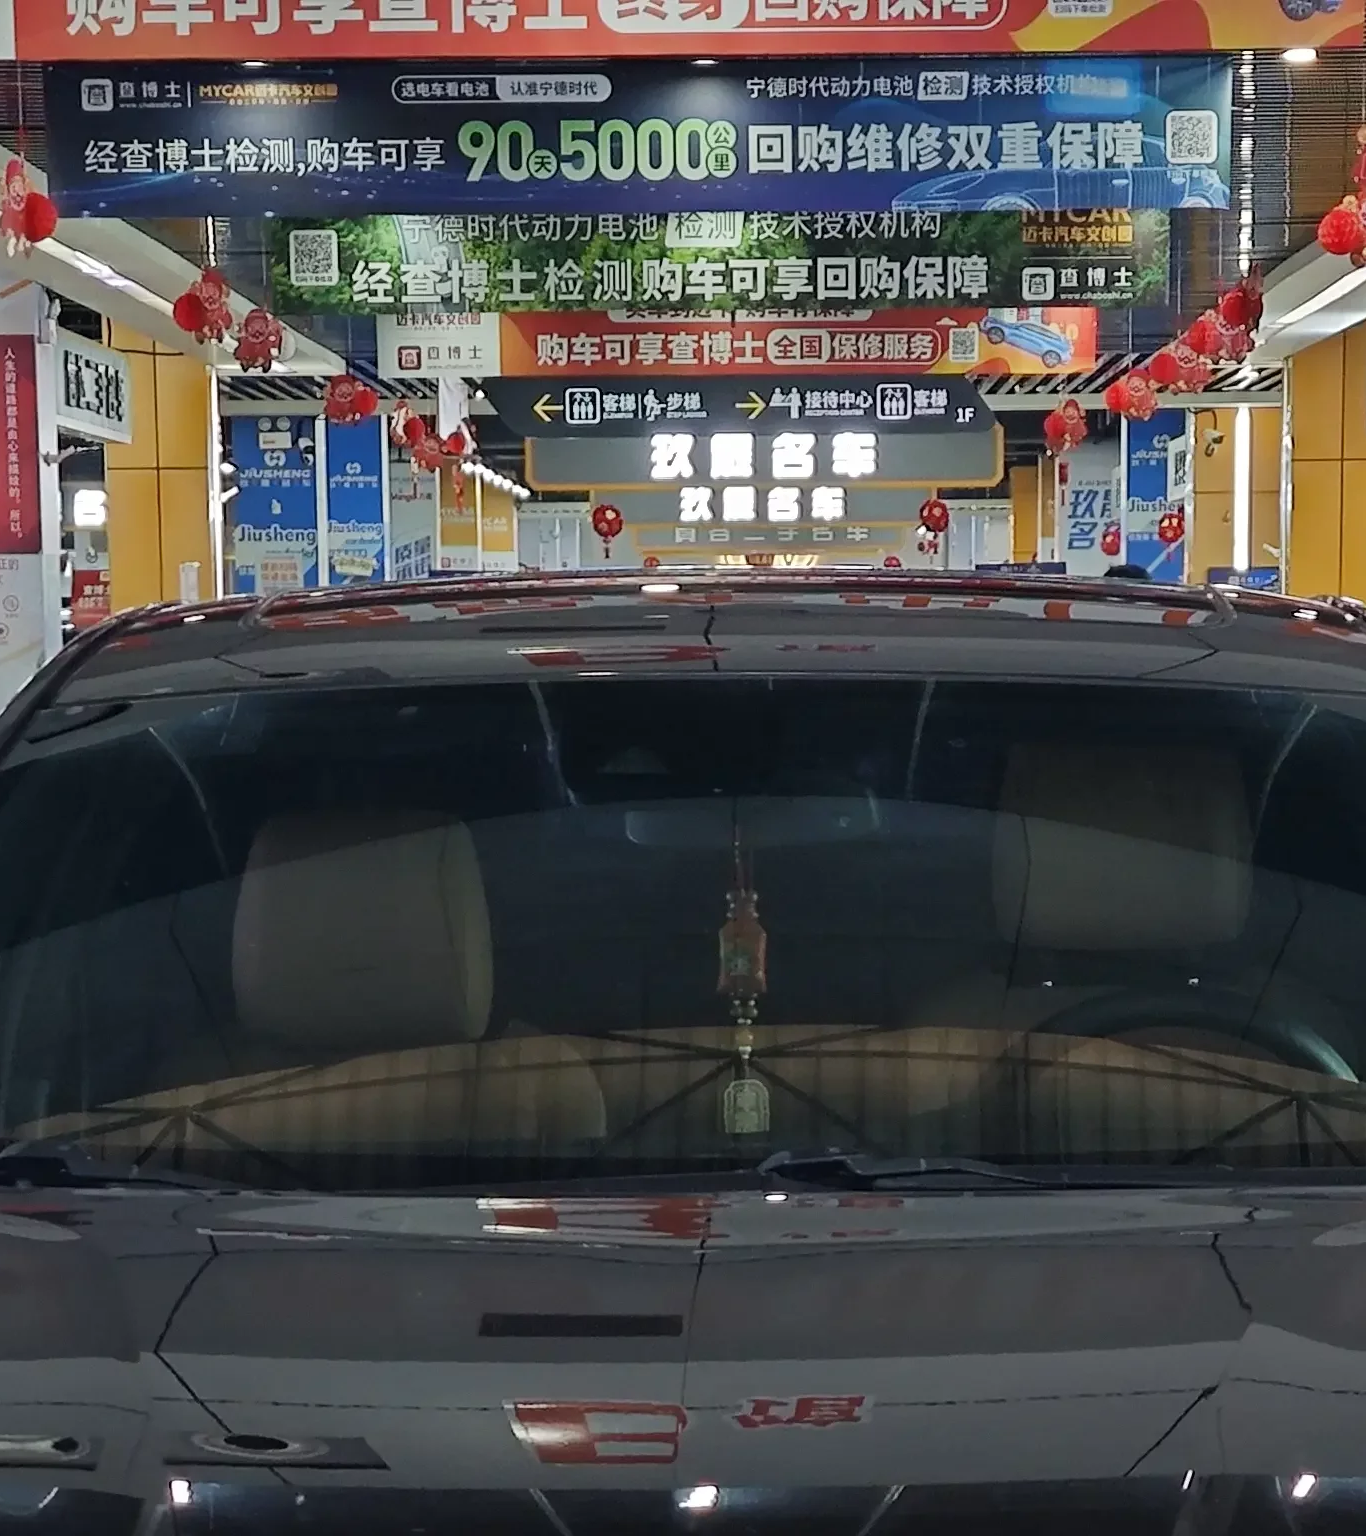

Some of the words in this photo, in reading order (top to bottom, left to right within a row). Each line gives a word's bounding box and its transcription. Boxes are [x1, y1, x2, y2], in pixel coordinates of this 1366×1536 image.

[119, 81, 182, 98] 查博士
[400, 81, 490, 97] 选电车看电池
[509, 80, 599, 97] 认准宁德时代
[747, 120, 1144, 175] 回购维修双重保障
[351, 256, 990, 304] 经查博士检测购车可享回购保障
[1059, 267, 1134, 289] 查博士
[426, 345, 483, 360] 查博士
[602, 392, 637, 411] 客梯
[666, 391, 702, 411] 步梯
[804, 389, 874, 409] 接待中心
[913, 389, 949, 409] 客梯
[954, 407, 975, 423] 1F
[238, 525, 317, 546] Jiusheng
